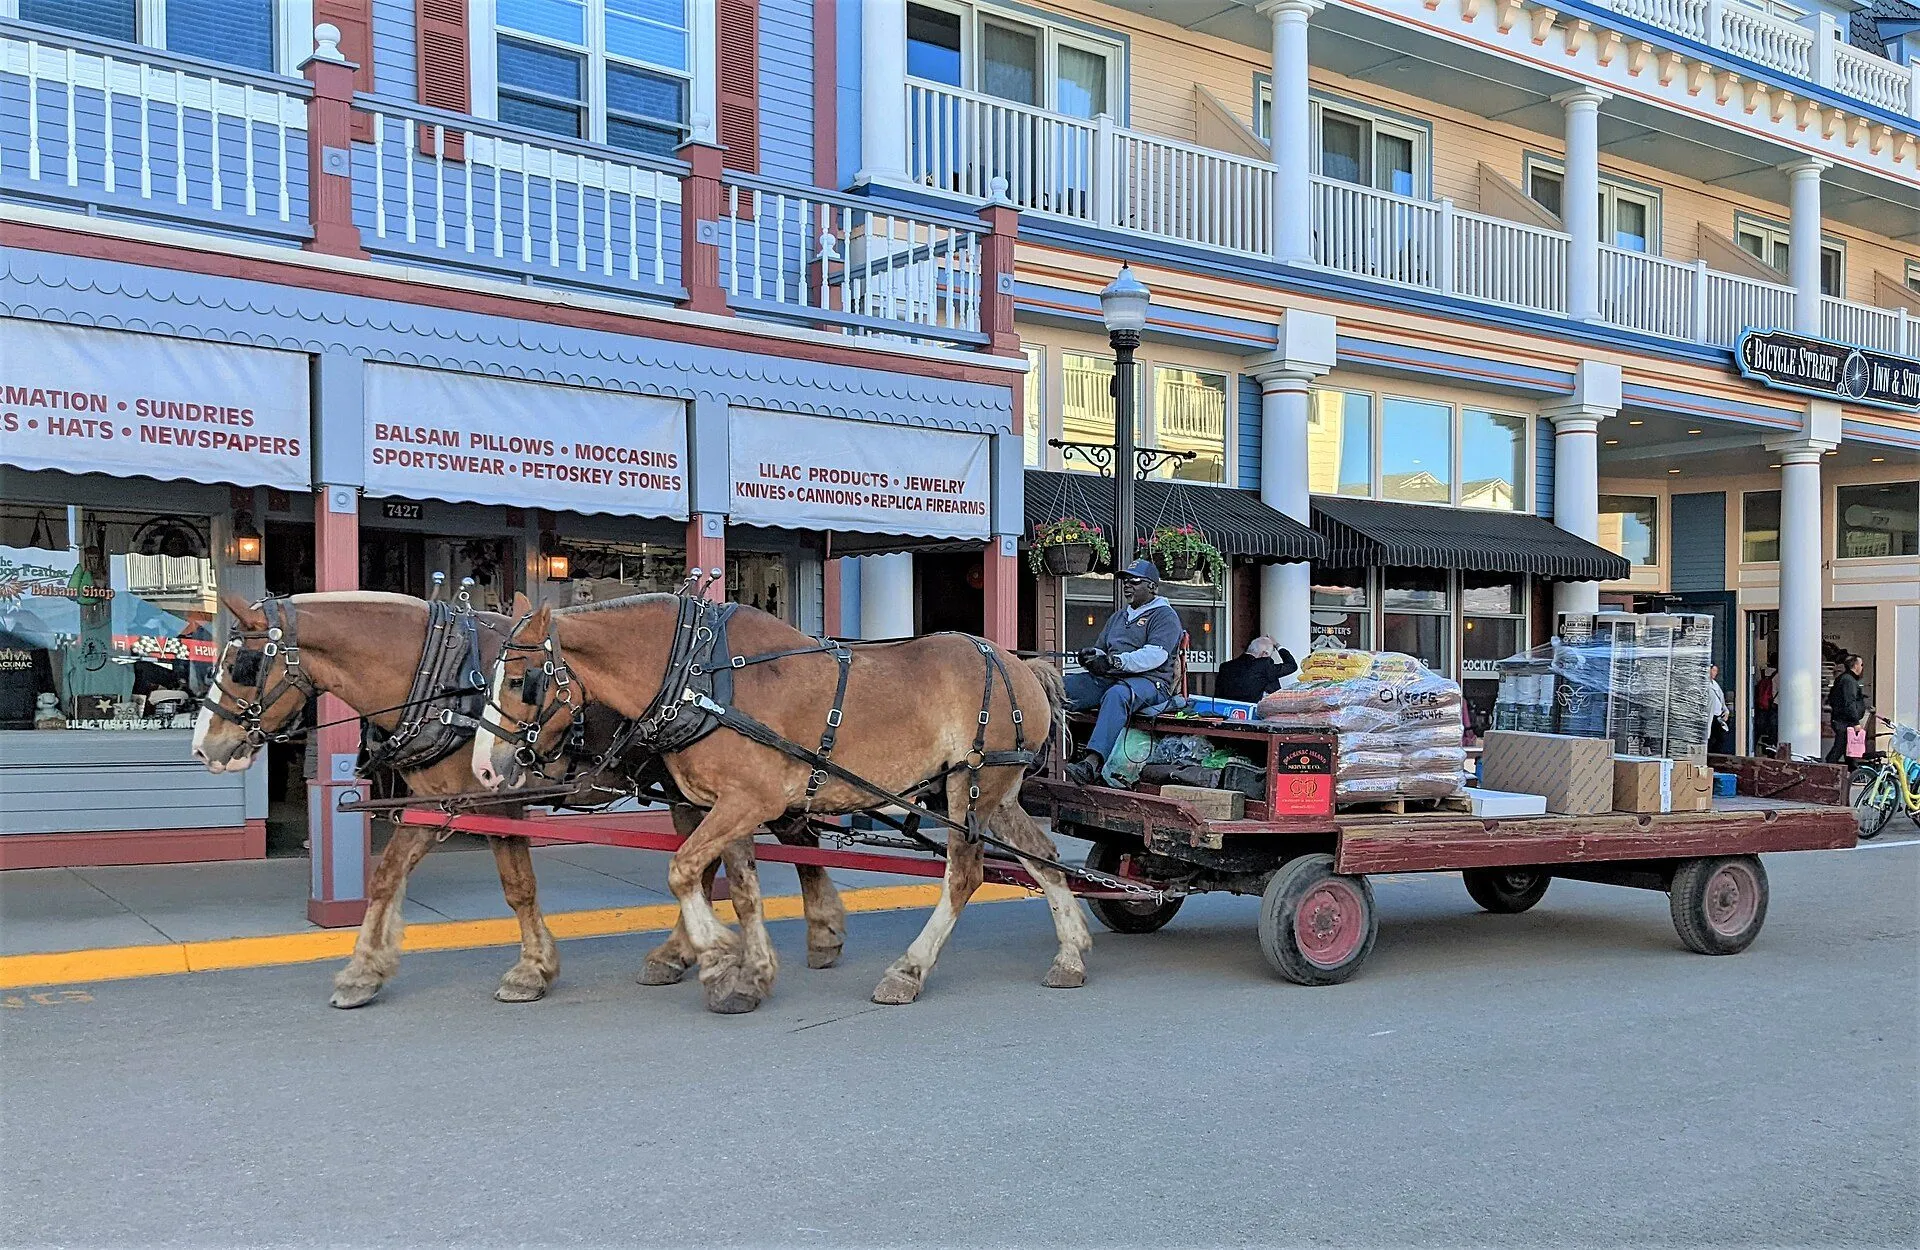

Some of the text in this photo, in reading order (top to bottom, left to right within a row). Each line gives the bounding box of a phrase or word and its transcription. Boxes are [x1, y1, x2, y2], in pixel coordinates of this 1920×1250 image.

[1754, 338, 1838, 382] BICYCLE STREET
[1872, 362, 1890, 392] INN
[1892, 370, 1899, 394] &
[0, 386, 254, 427] MATION SUNDRIES
[48, 417, 113, 440] HATS
[141, 425, 300, 456] NEWSPAPERS
[375, 424, 677, 469] BALSAM PILLOWS MOCCASINS
[373, 448, 681, 491] SPORTSWEAR PETOSKEY STONES
[760, 463, 965, 494] LILAC PRODUCTS JEWELRY
[387, 504, 419, 518] 7427
[736, 482, 985, 515] KNIVES CANNONS REPLICA FIREARMS
[0, 556, 13, 566] he
[32, 583, 115, 599] Balsam Shop
[1311, 626, 1351, 635] INCHESTER'S
[1462, 659, 1499, 671] COCKTA
[66, 720, 95, 729] LILAC
